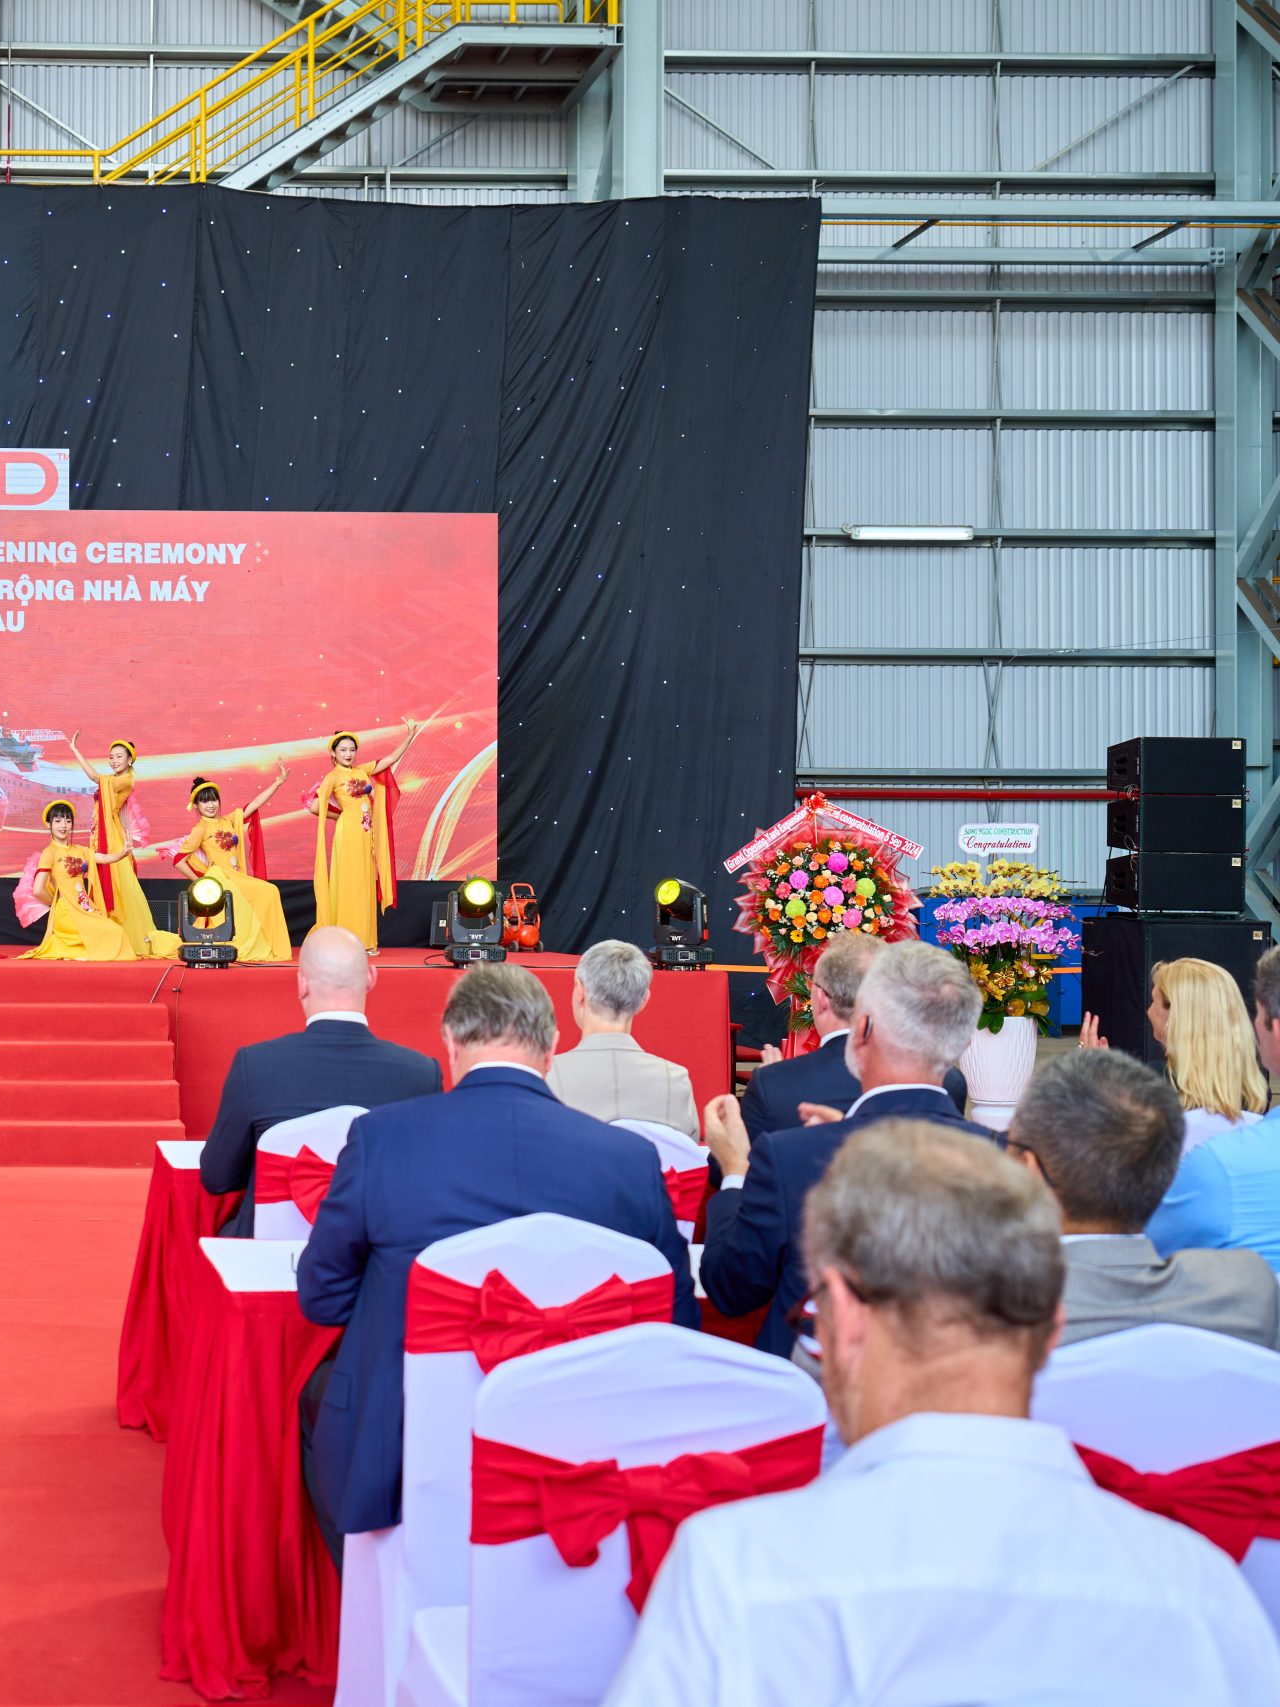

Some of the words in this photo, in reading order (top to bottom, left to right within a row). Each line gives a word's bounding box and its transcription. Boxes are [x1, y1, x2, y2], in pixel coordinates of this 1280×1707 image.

[85, 541, 247, 565] CEREMONY
[83, 574, 142, 601] NHÀ
[150, 575, 210, 602] MÁY
[727, 851, 746, 869] Grand
[742, 838, 769, 859] Opening
[764, 827, 781, 842] Yard
[839, 813, 885, 839] congratulation
[883, 831, 891, 842] 5
[889, 835, 903, 849] Sep
[901, 842, 920, 856] 2024
[963, 835, 1032, 852] Congratulations
